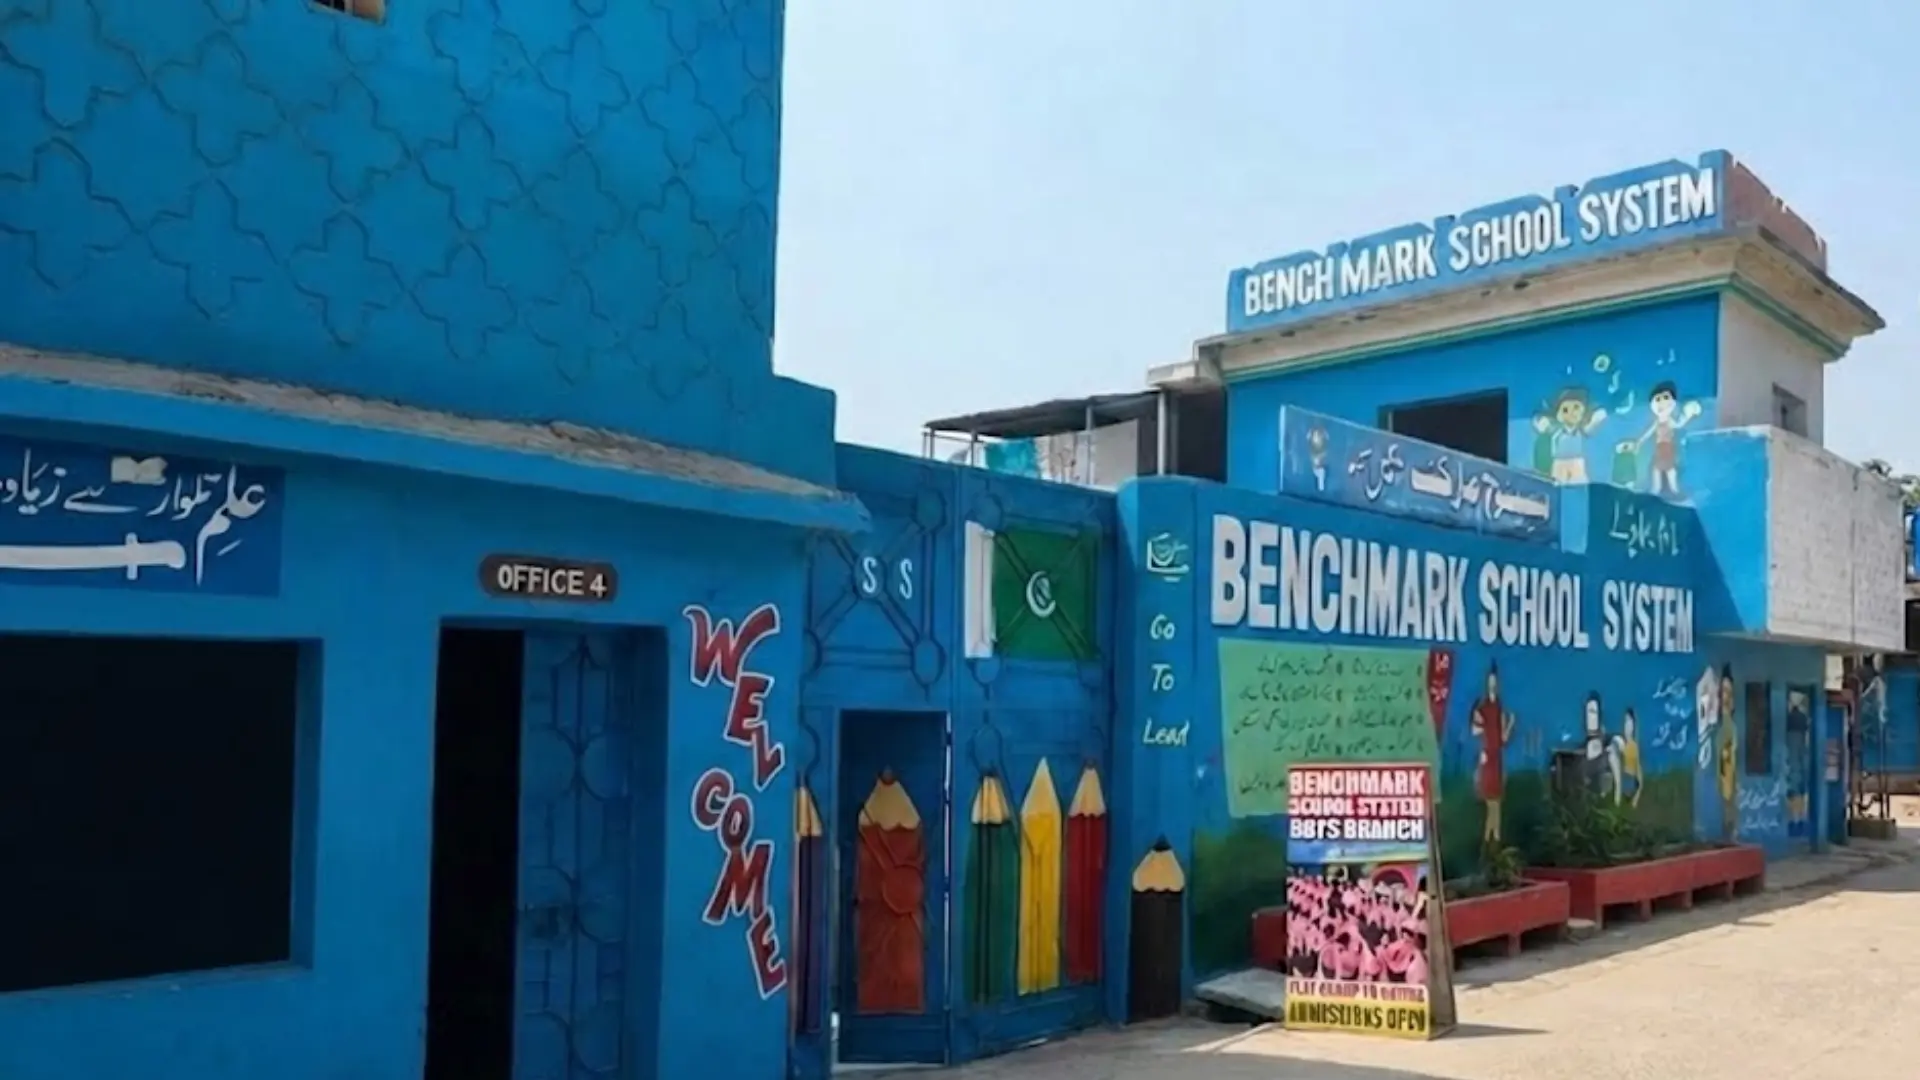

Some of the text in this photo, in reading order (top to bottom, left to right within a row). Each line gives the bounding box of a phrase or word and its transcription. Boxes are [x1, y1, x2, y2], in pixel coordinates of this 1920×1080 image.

[1245, 168, 1715, 316] BENCH MARK SCHOOL SYSTEM
[497, 564, 607, 598] OFFICE 4
[863, 556, 913, 599] S S
[1210, 513, 1694, 653] BENCHMARK SCHOOL SYSTEM
[1151, 663, 1174, 691] To
